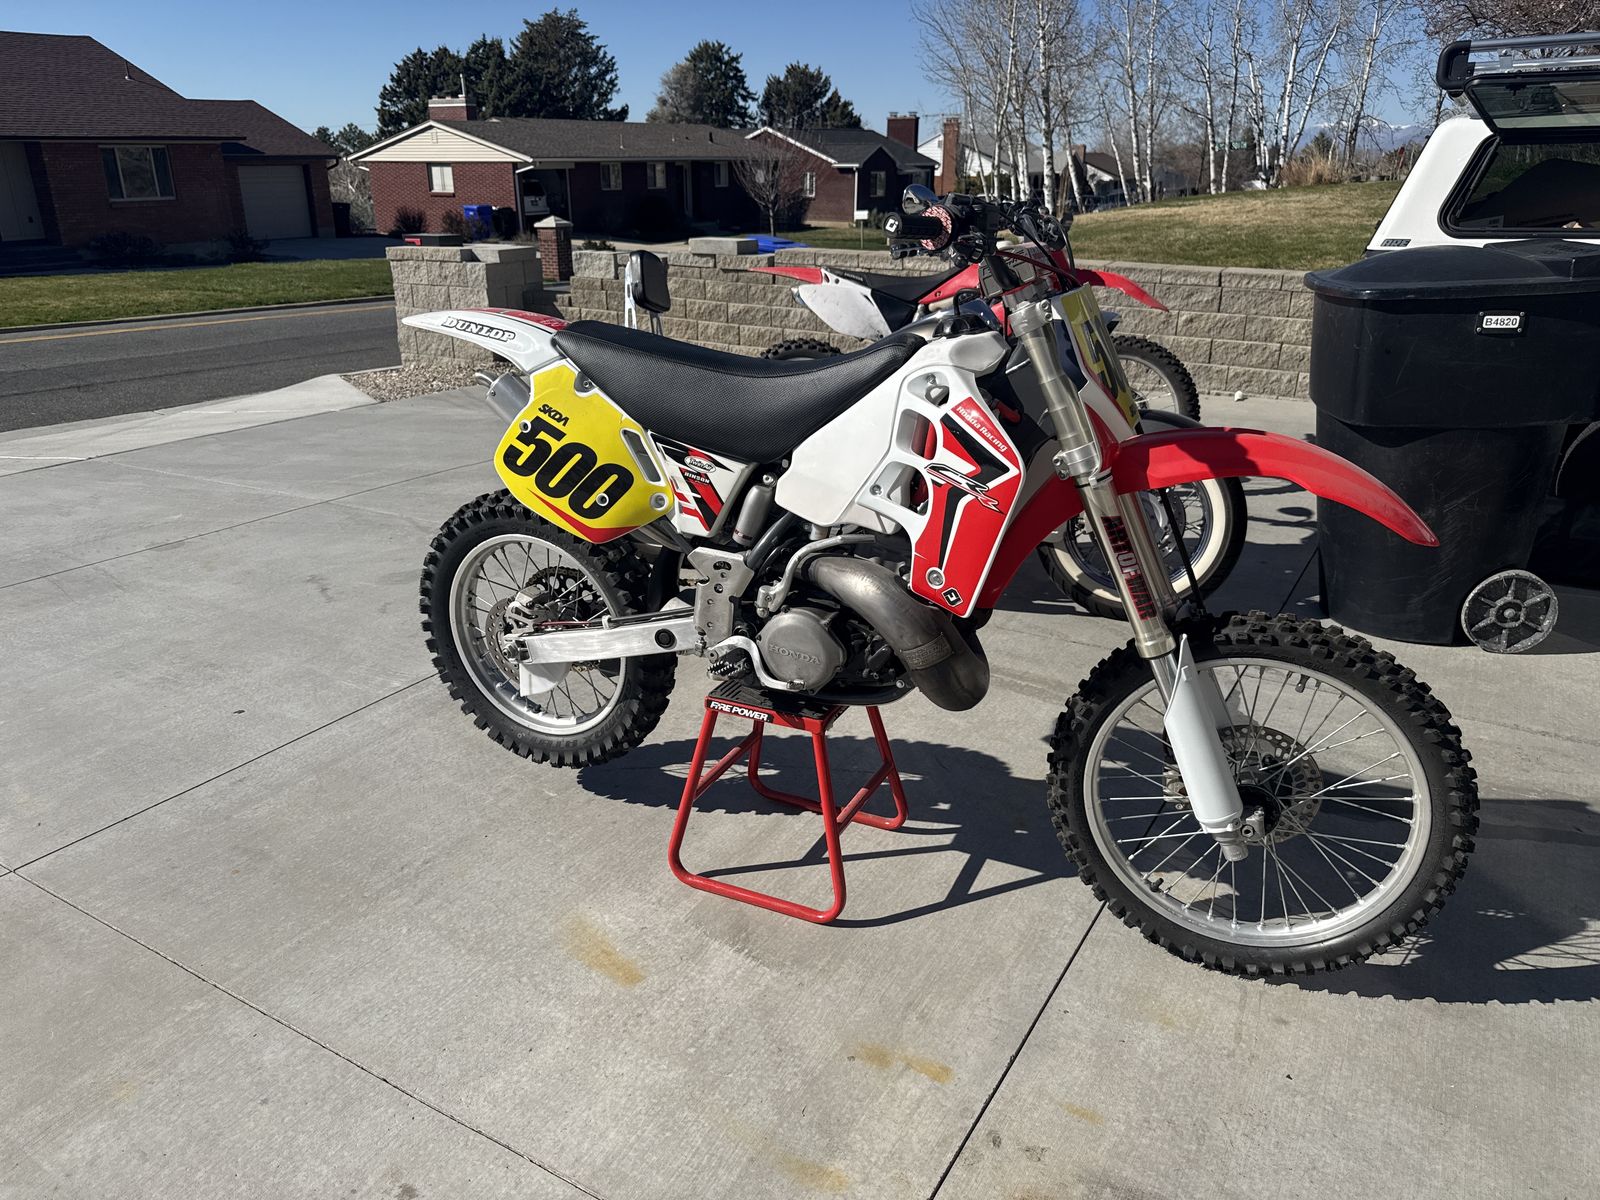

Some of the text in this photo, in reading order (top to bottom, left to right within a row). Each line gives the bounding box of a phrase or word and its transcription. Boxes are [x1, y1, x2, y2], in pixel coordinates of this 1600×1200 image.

[441, 316, 516, 342] DUNLOP
[1484, 317, 1518, 327] B4820
[538, 403, 570, 427] SKDA
[980, 424, 1008, 453] Racing
[503, 415, 635, 520] 500
[684, 471, 710, 484] HINSON
[1117, 551, 1141, 579] OF
[1125, 574, 1157, 621] WAR
[769, 644, 821, 665] HONDA
[731, 706, 768, 721] POWER
